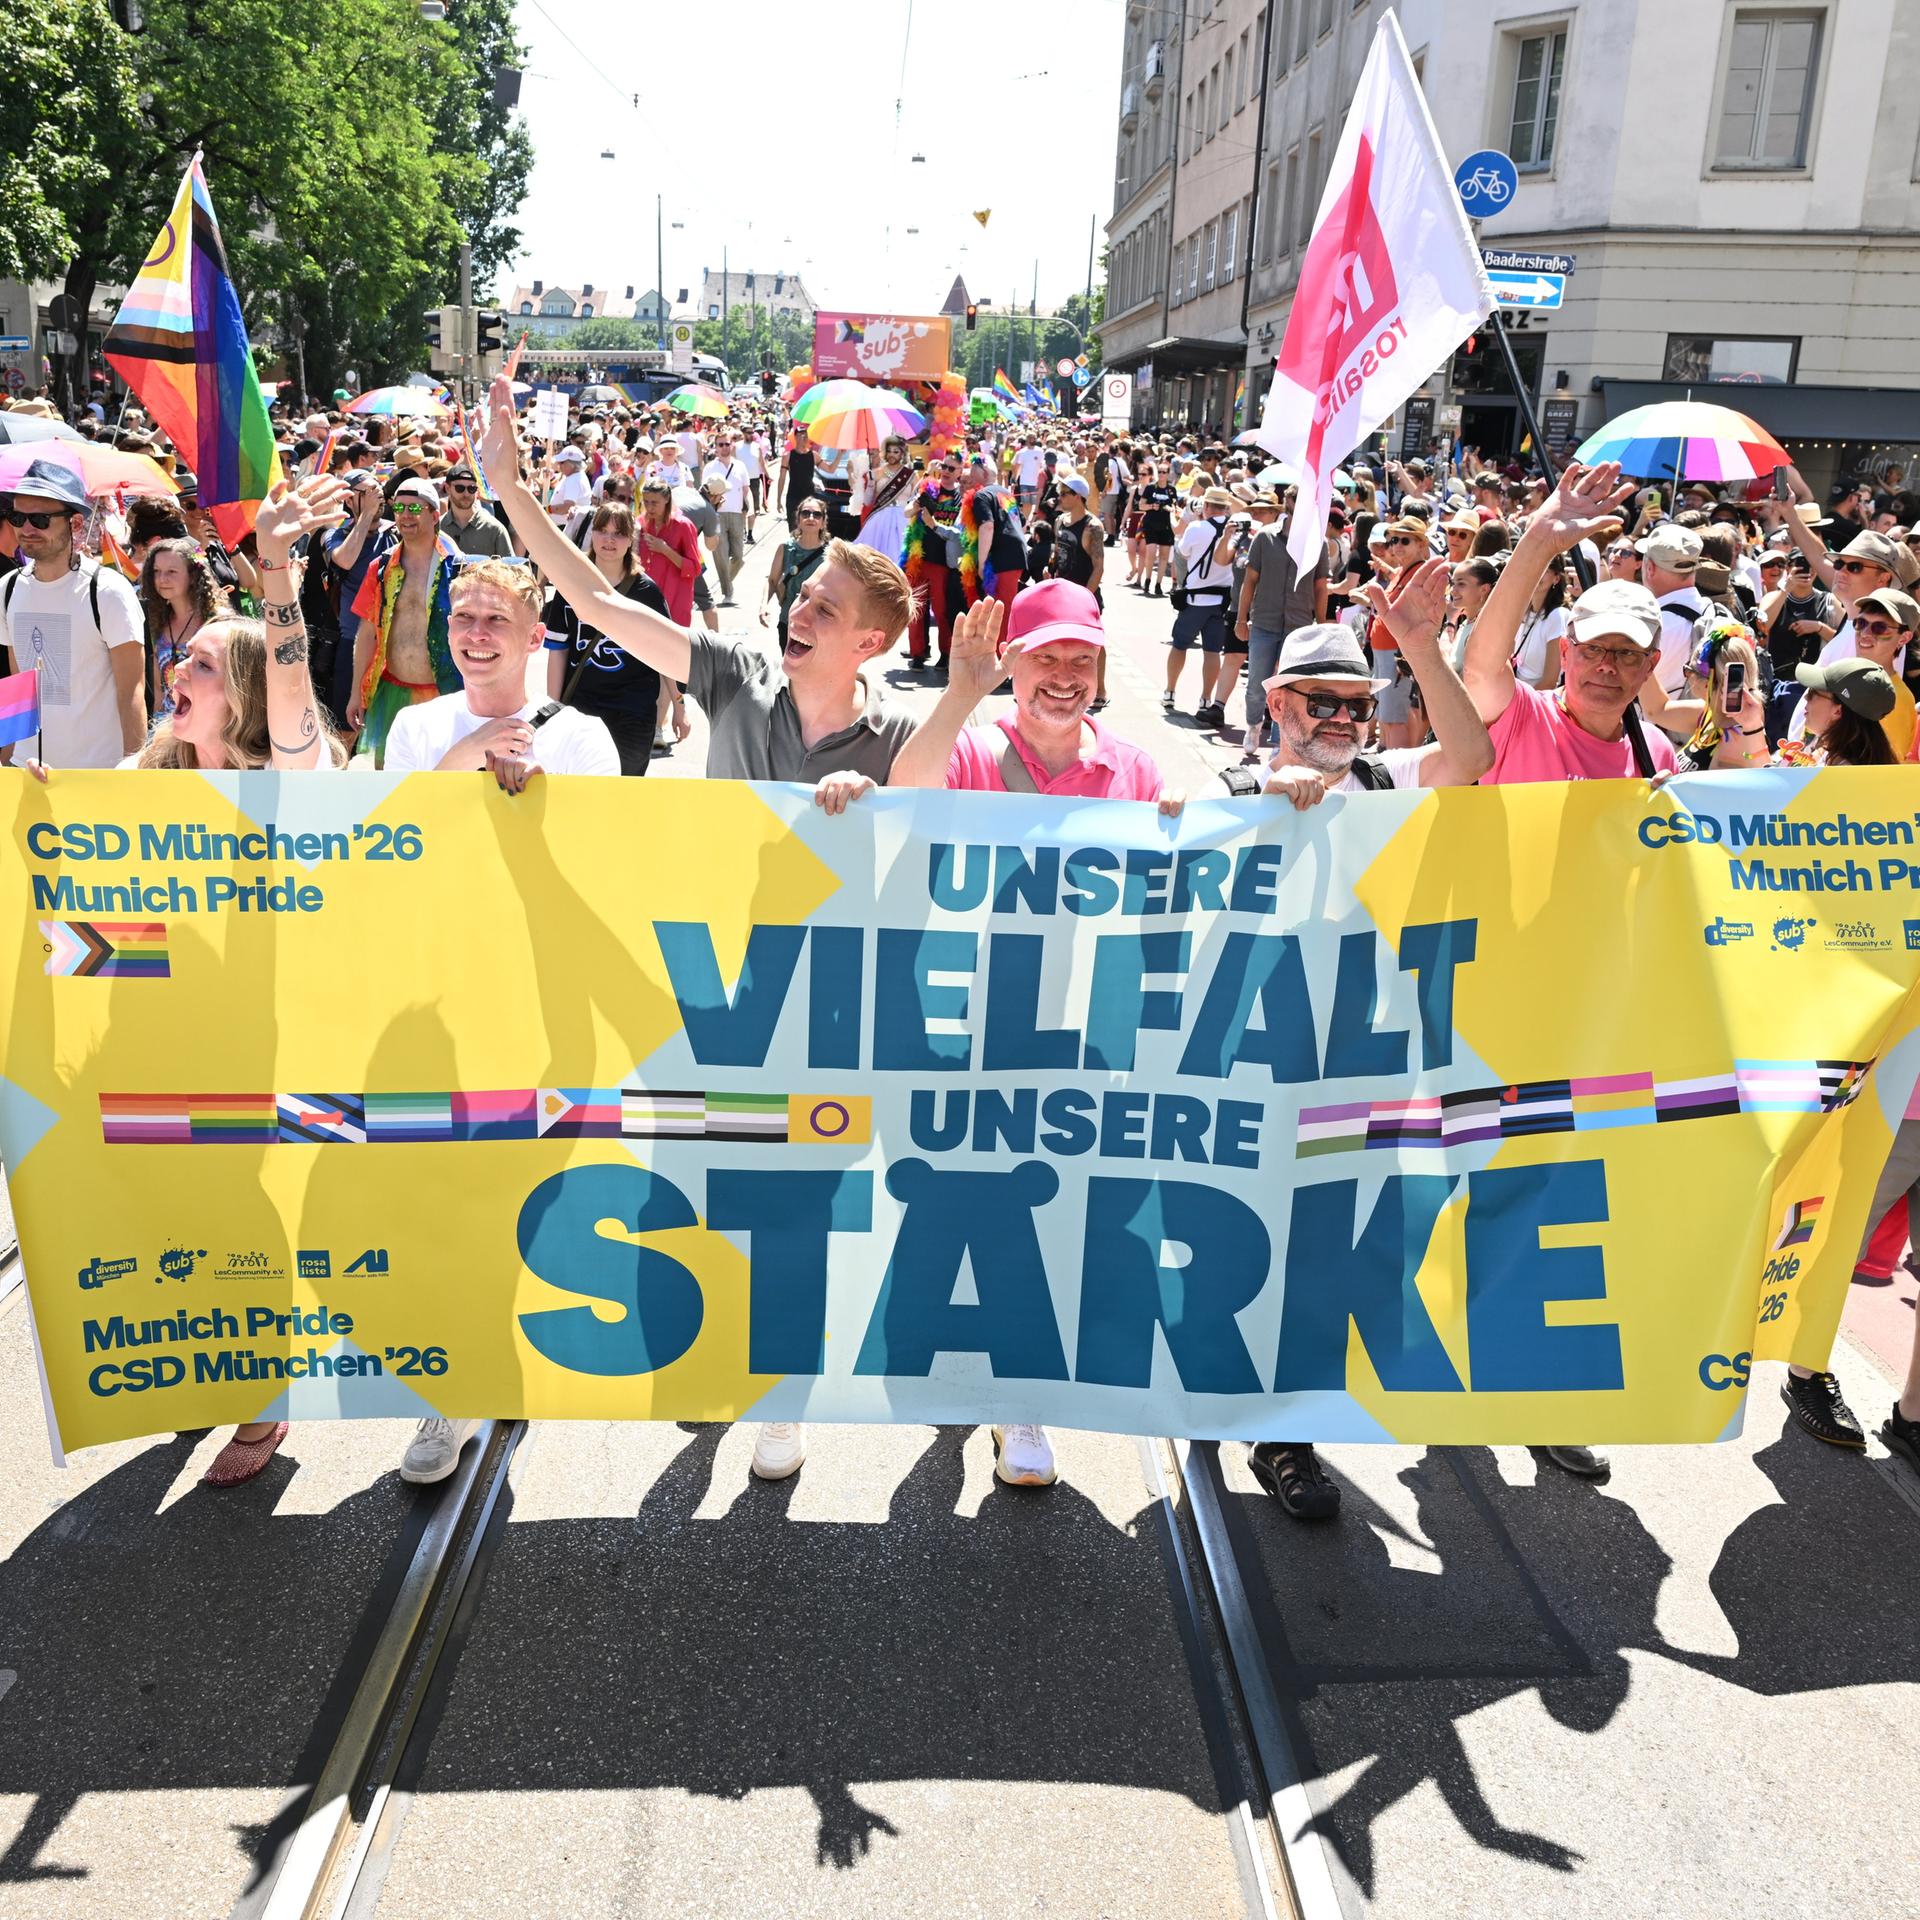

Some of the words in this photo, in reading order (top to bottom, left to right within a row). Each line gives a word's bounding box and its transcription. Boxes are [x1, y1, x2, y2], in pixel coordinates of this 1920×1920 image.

[1484, 251, 1568, 272] Baaderstraße
[862, 331, 901, 360] sub
[27, 823, 130, 861] CSD
[1638, 811, 1722, 849] CSD
[929, 842, 1282, 917] UNSERE
[1728, 859, 1873, 892] Munich
[32, 874, 197, 913] Munich
[206, 876, 323, 913] Pride
[1720, 923, 1752, 936] diversity
[1777, 924, 1801, 942] sub
[1823, 939, 1878, 948] LesCommunity
[651, 917, 1478, 1084] VIELFALT
[909, 1087, 1265, 1171] UNSERE
[95, 1260, 136, 1276] diversity
[163, 1257, 191, 1273] sub
[213, 1269, 271, 1277] LesCommunity
[272, 1268, 286, 1276] e.V.
[300, 1259, 327, 1267] rosa
[301, 1267, 327, 1275] liste
[516, 1156, 1625, 1395] STÄRKE
[1761, 1252, 1800, 1286] Pride
[83, 1308, 240, 1353] Munich
[246, 1305, 354, 1338] Pride
[88, 1356, 186, 1398] CSD
